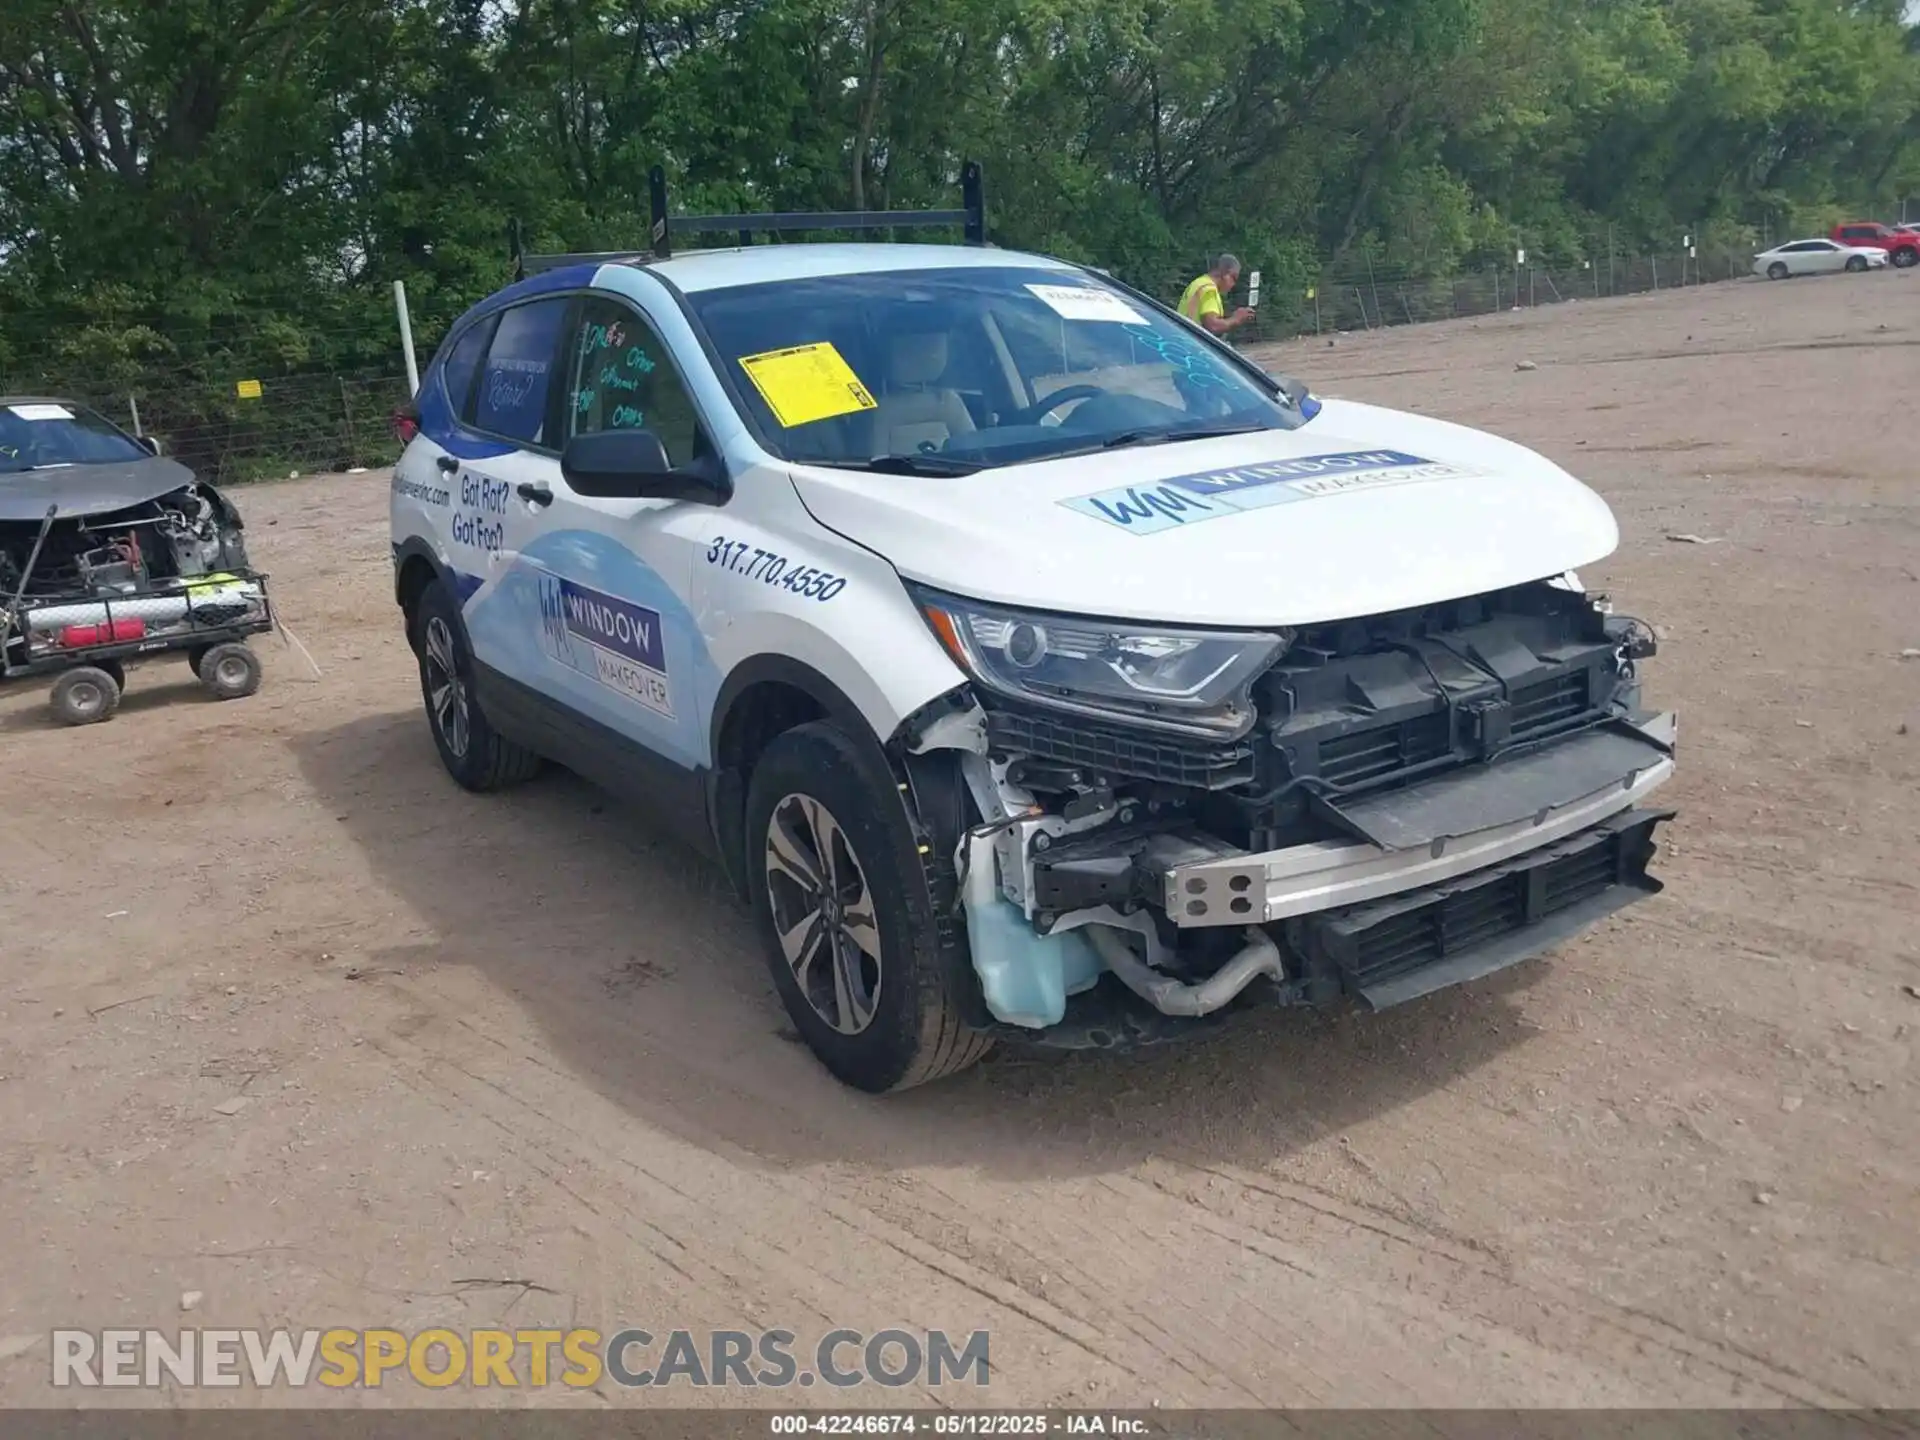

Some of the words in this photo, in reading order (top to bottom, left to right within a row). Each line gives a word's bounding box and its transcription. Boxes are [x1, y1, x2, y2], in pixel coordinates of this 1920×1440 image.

[461, 474, 481, 507] Got
[482, 477, 509, 515] Rot?
[1090, 487, 1213, 524] WM
[1194, 451, 1398, 486] WINDOW
[1303, 463, 1459, 493] MAKEOVER
[452, 511, 476, 547] Got
[476, 517, 504, 561] Fog?
[707, 536, 847, 602] 317.770.4550
[567, 591, 650, 653] WINDOW
[598, 656, 671, 709] MAKEOVER
